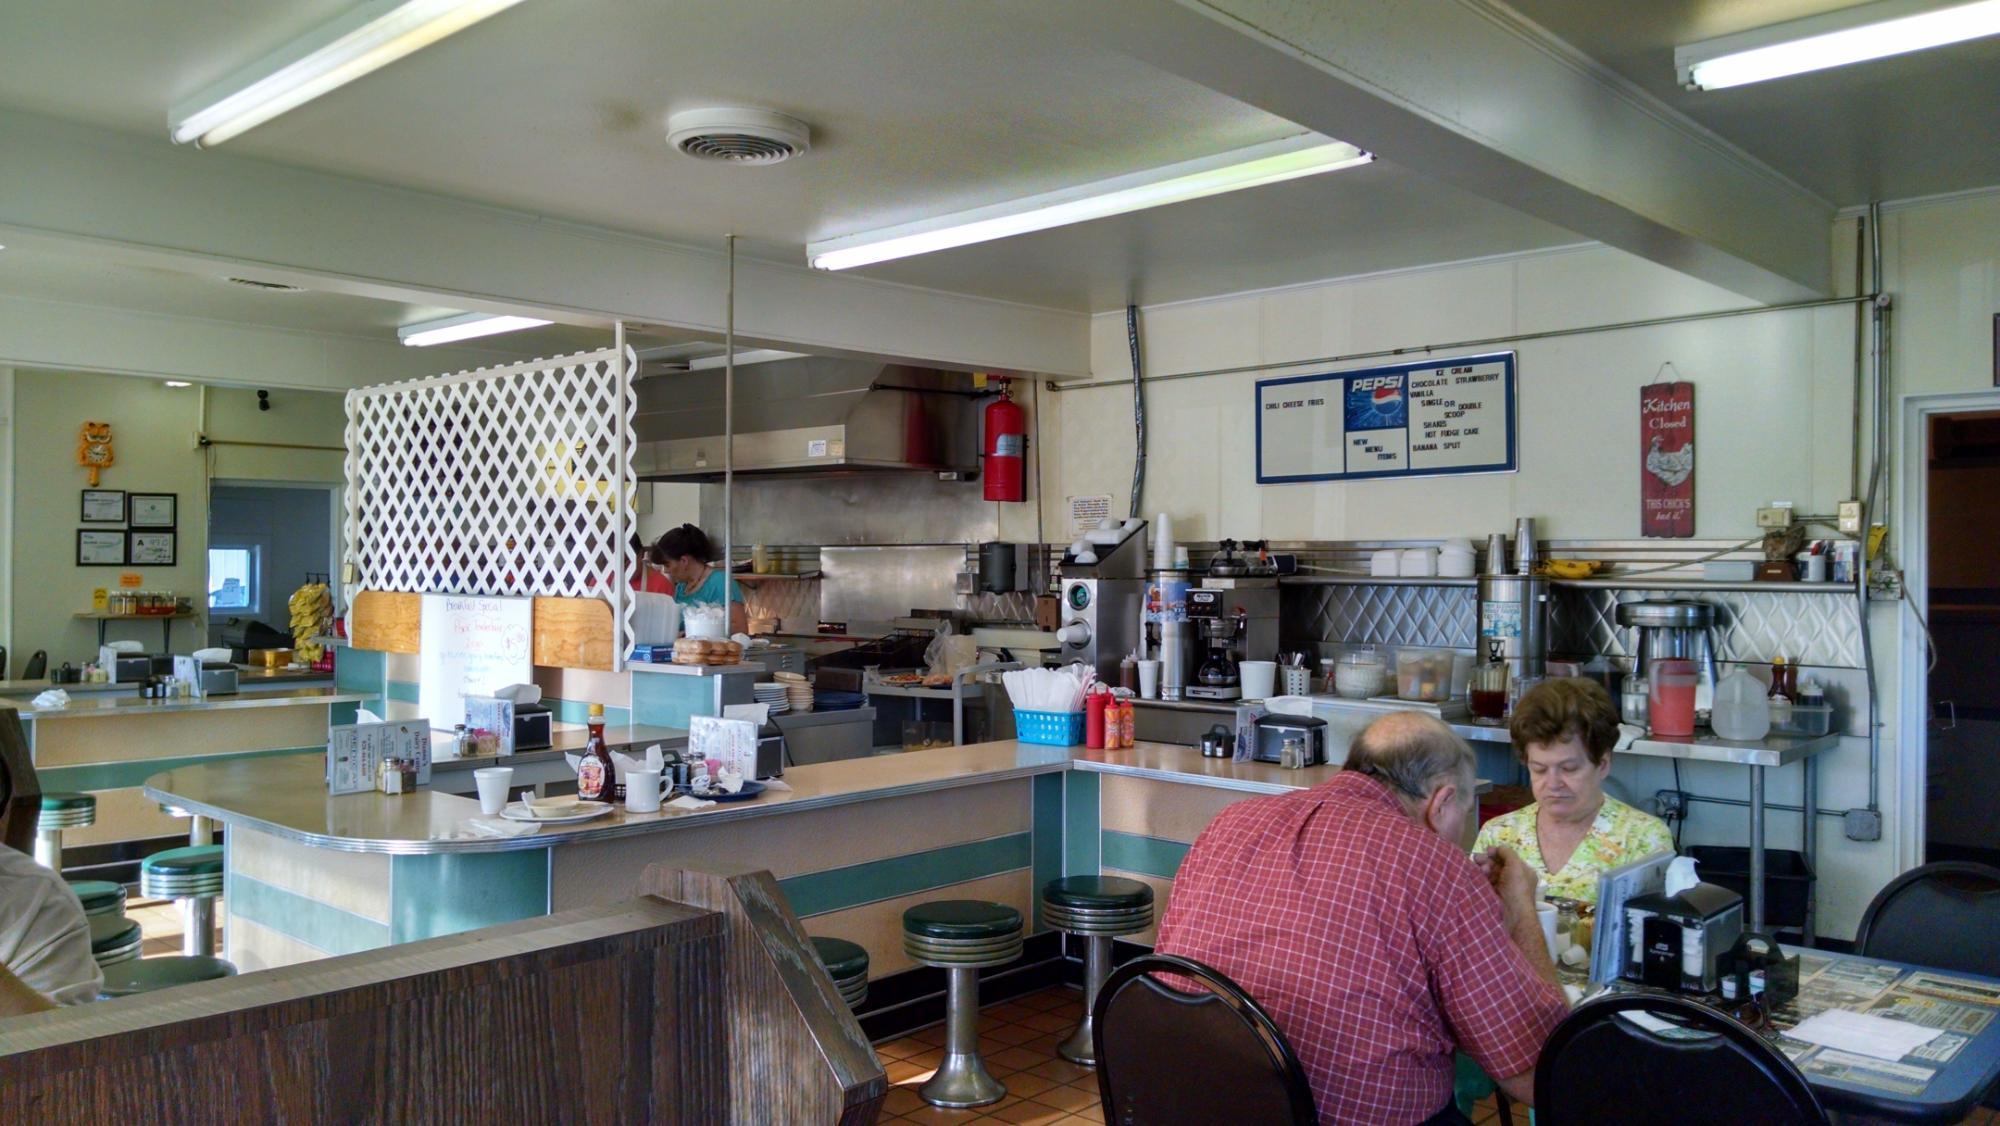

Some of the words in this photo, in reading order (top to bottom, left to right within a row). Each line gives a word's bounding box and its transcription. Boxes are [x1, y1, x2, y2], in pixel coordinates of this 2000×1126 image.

[1352, 375, 1404, 392] PEPSI
[1411, 378, 1448, 388] CHOCOLATE
[1455, 373, 1500, 384] STRAWBERRY
[1410, 390, 1434, 398] VANILLA
[1282, 400, 1304, 408] CHEESE
[1308, 398, 1324, 406] FRIES
[1421, 398, 1442, 407] SINGLE
[1458, 402, 1482, 410] DOUBLE
[1642, 398, 1690, 414] Kitchen
[1444, 410, 1466, 418] SCOOP
[1423, 420, 1447, 428] SHAKES
[1649, 416, 1687, 429] Closed
[1425, 430, 1436, 438] HOT
[1440, 429, 1460, 438] FUDGE
[1464, 427, 1480, 435] CAKE
[1412, 443, 1438, 452] BANANA
[1646, 499, 1662, 510] THIS
